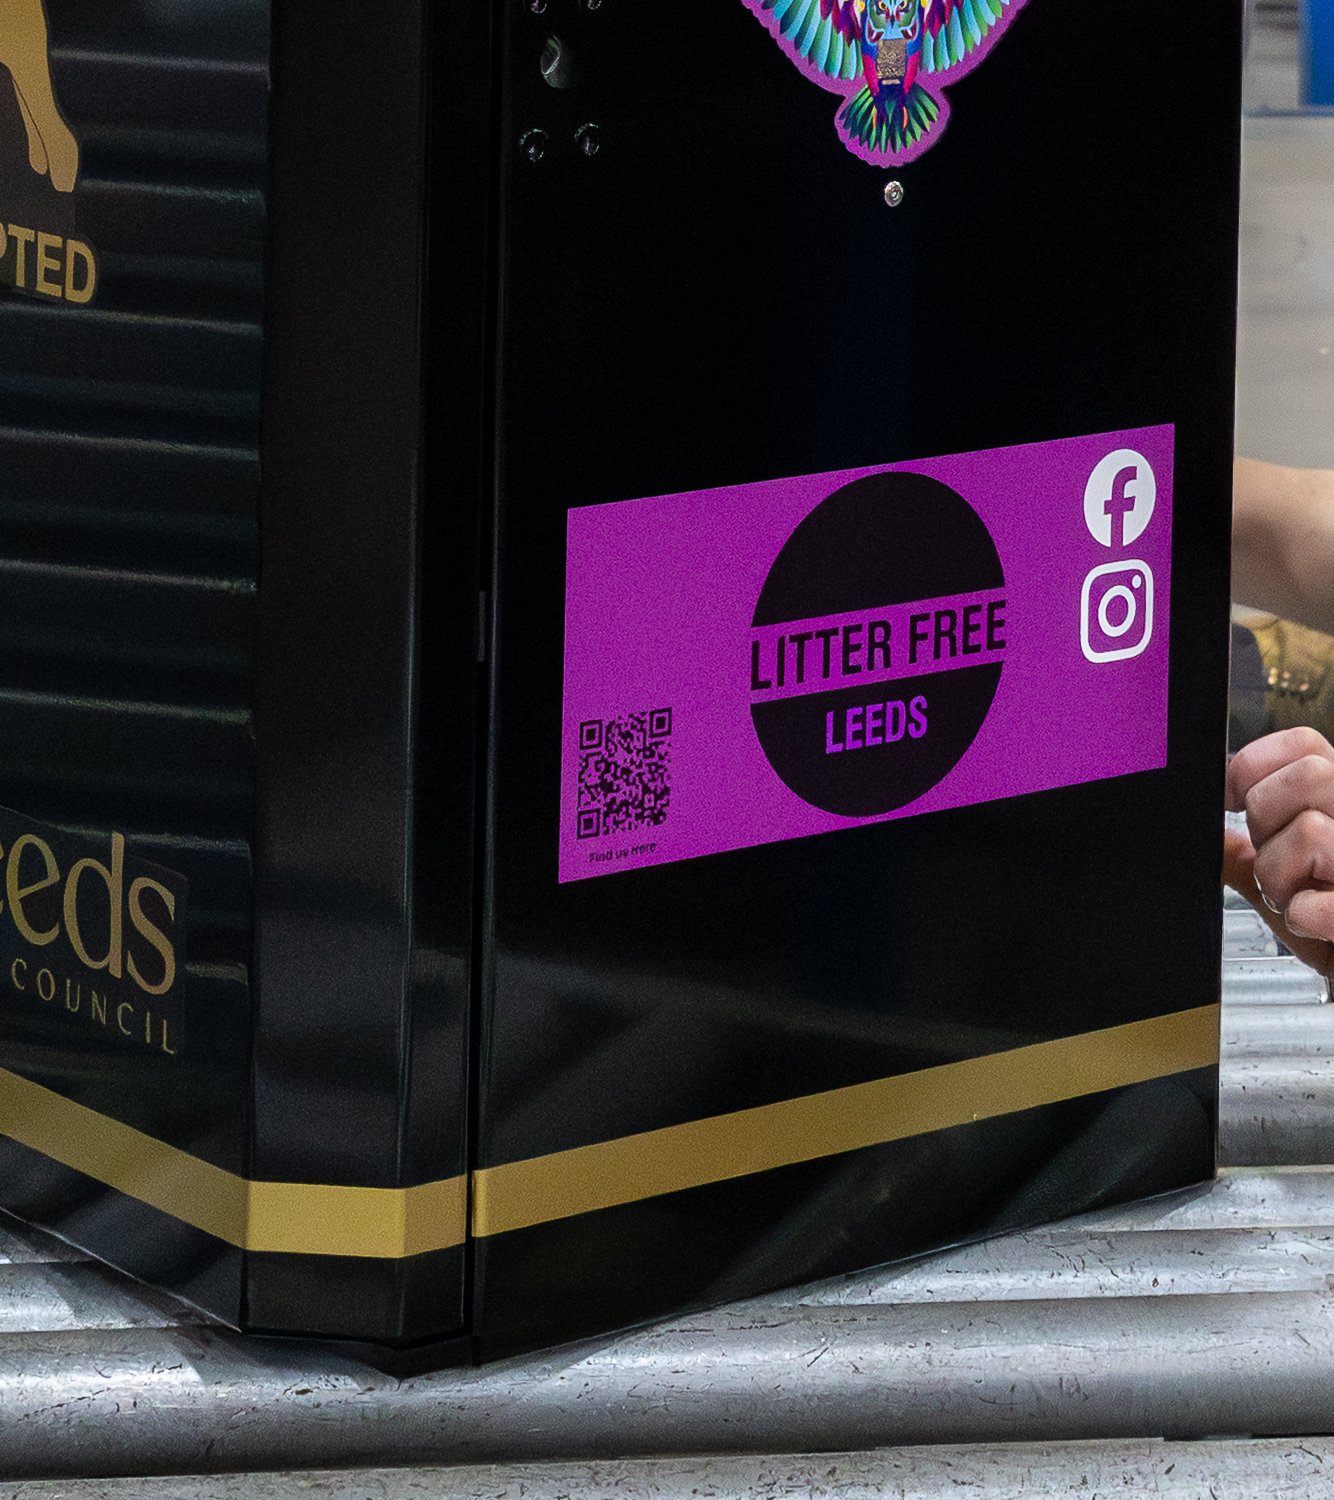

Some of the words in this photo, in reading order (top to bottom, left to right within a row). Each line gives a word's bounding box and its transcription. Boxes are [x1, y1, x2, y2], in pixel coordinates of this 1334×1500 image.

[750, 618, 893, 691] LITTER
[907, 599, 1008, 665] FREE
[825, 695, 928, 754] LEEDS
[11, 957, 175, 1055] COUNCIL
